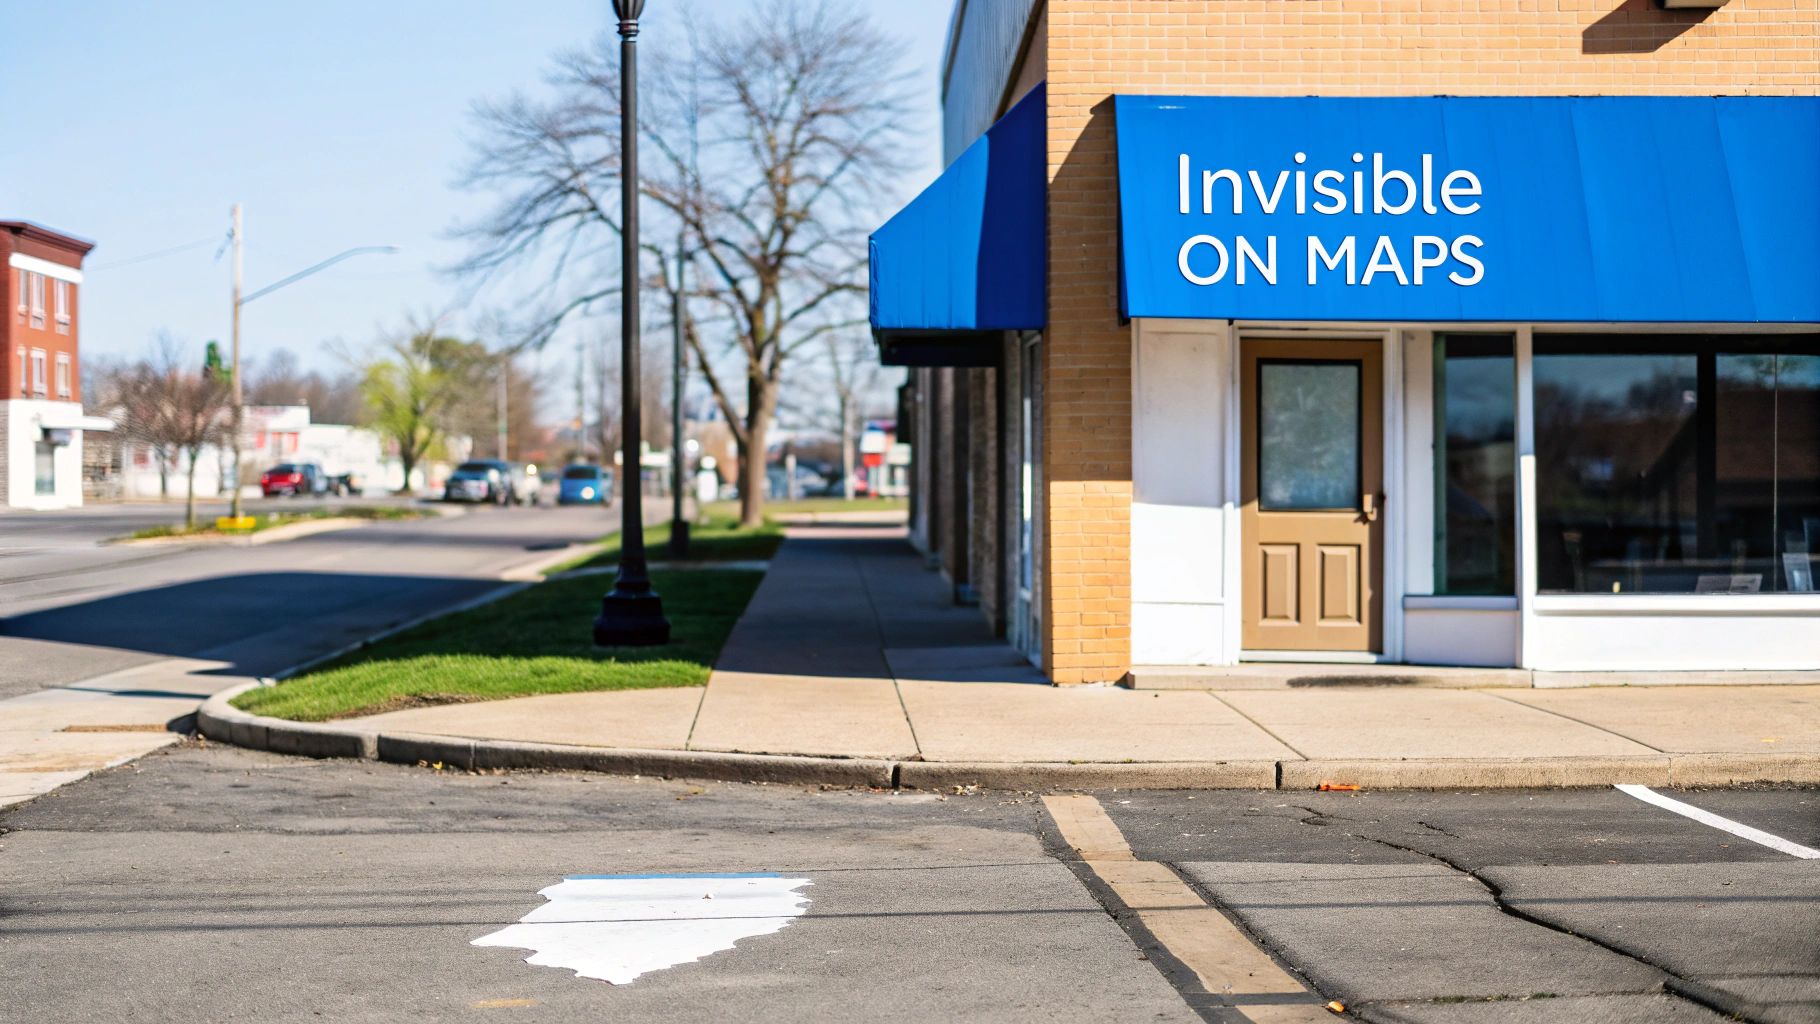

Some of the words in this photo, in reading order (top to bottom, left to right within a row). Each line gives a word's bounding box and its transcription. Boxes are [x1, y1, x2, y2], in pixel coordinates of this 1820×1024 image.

[1179, 152, 1483, 215] Invisible
[1178, 234, 1278, 286] ON
[1306, 234, 1486, 286] MAPS
